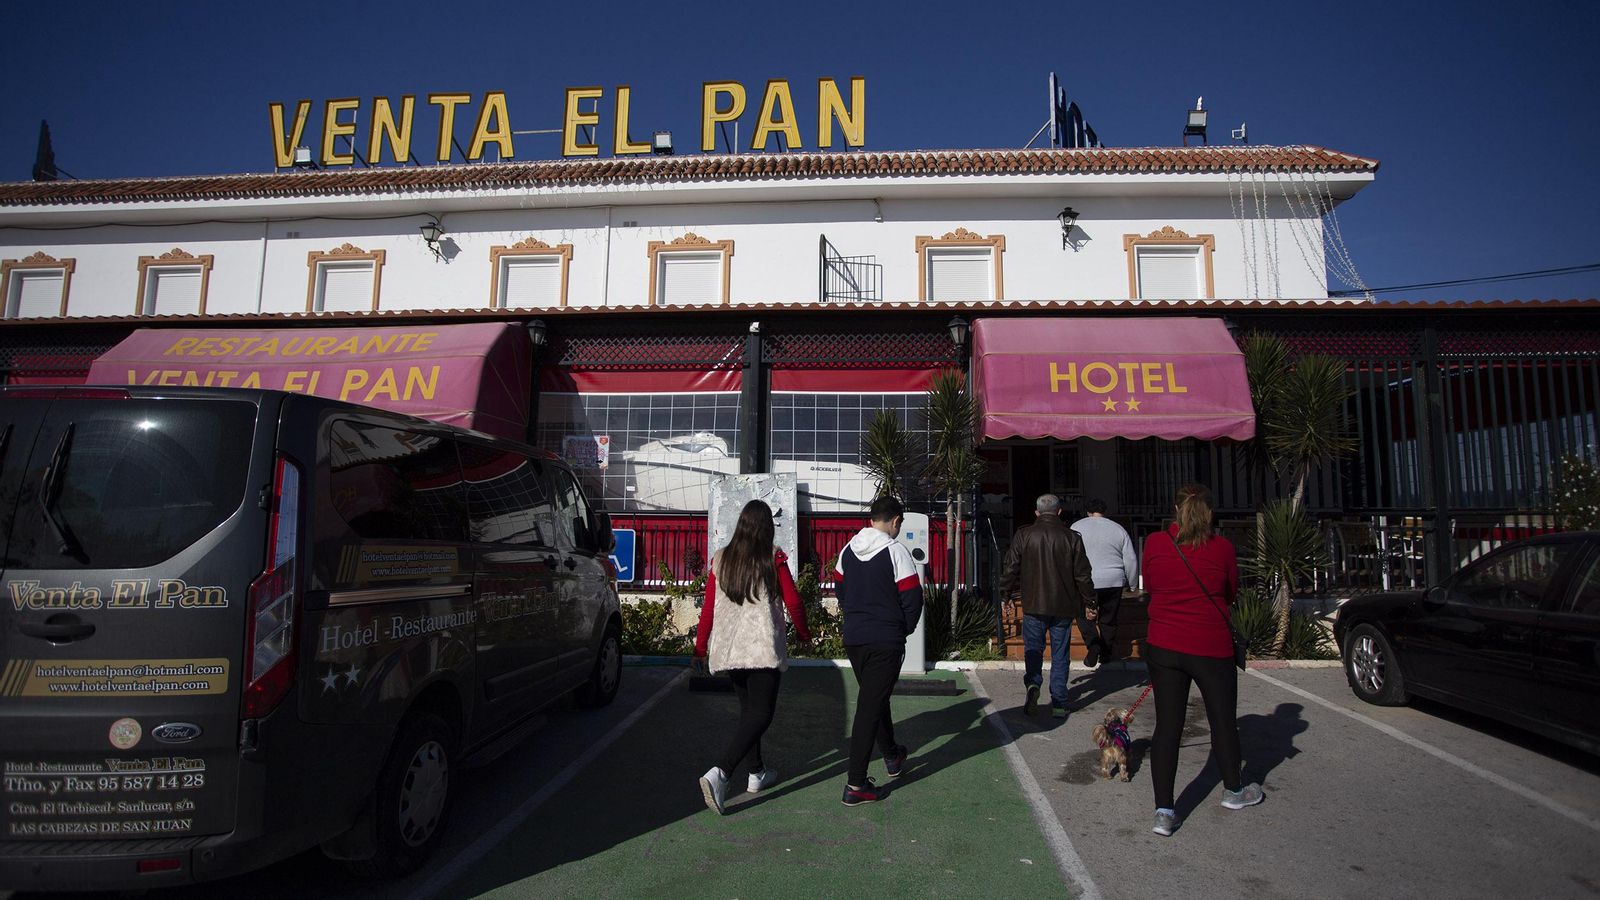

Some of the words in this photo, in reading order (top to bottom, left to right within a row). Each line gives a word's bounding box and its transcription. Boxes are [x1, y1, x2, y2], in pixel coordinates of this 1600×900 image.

[269, 90, 514, 168] VENTA
[562, 86, 651, 157] EL
[702, 76, 865, 151] PAN
[163, 332, 438, 356] RESTAURANTE
[340, 366, 440, 402] PAN
[1049, 362, 1188, 393] HOTEL
[8, 579, 103, 610] Venta
[107, 578, 151, 609] El
[155, 578, 229, 608] Pan
[320, 617, 379, 653] Hotel
[36, 664, 224, 679] hotelventaelpan@hotmail.com
[49, 680, 209, 693] www.hotelventaelpan.com
[161, 727, 189, 738] Ford
[5, 760, 33, 773] Hotel
[105, 758, 151, 772] Venta
[151, 757, 171, 771] El
[172, 756, 206, 771] Pan
[4, 777, 46, 792] Tfno.
[50, 780, 60, 795] y
[65, 776, 94, 791] Fax
[98, 776, 118, 790] 95
[122, 775, 153, 789] 587
[159, 775, 178, 789] 14
[183, 774, 204, 788] 28
[10, 802, 39, 815] Ctra.
[42, 802, 56, 814] El
[175, 798, 194, 811] s/n
[10, 823, 36, 835] LAS
[39, 821, 98, 834] CABEZAS
[99, 821, 119, 833] DE
[122, 820, 151, 832] SAN
[153, 818, 192, 831] JUAN
